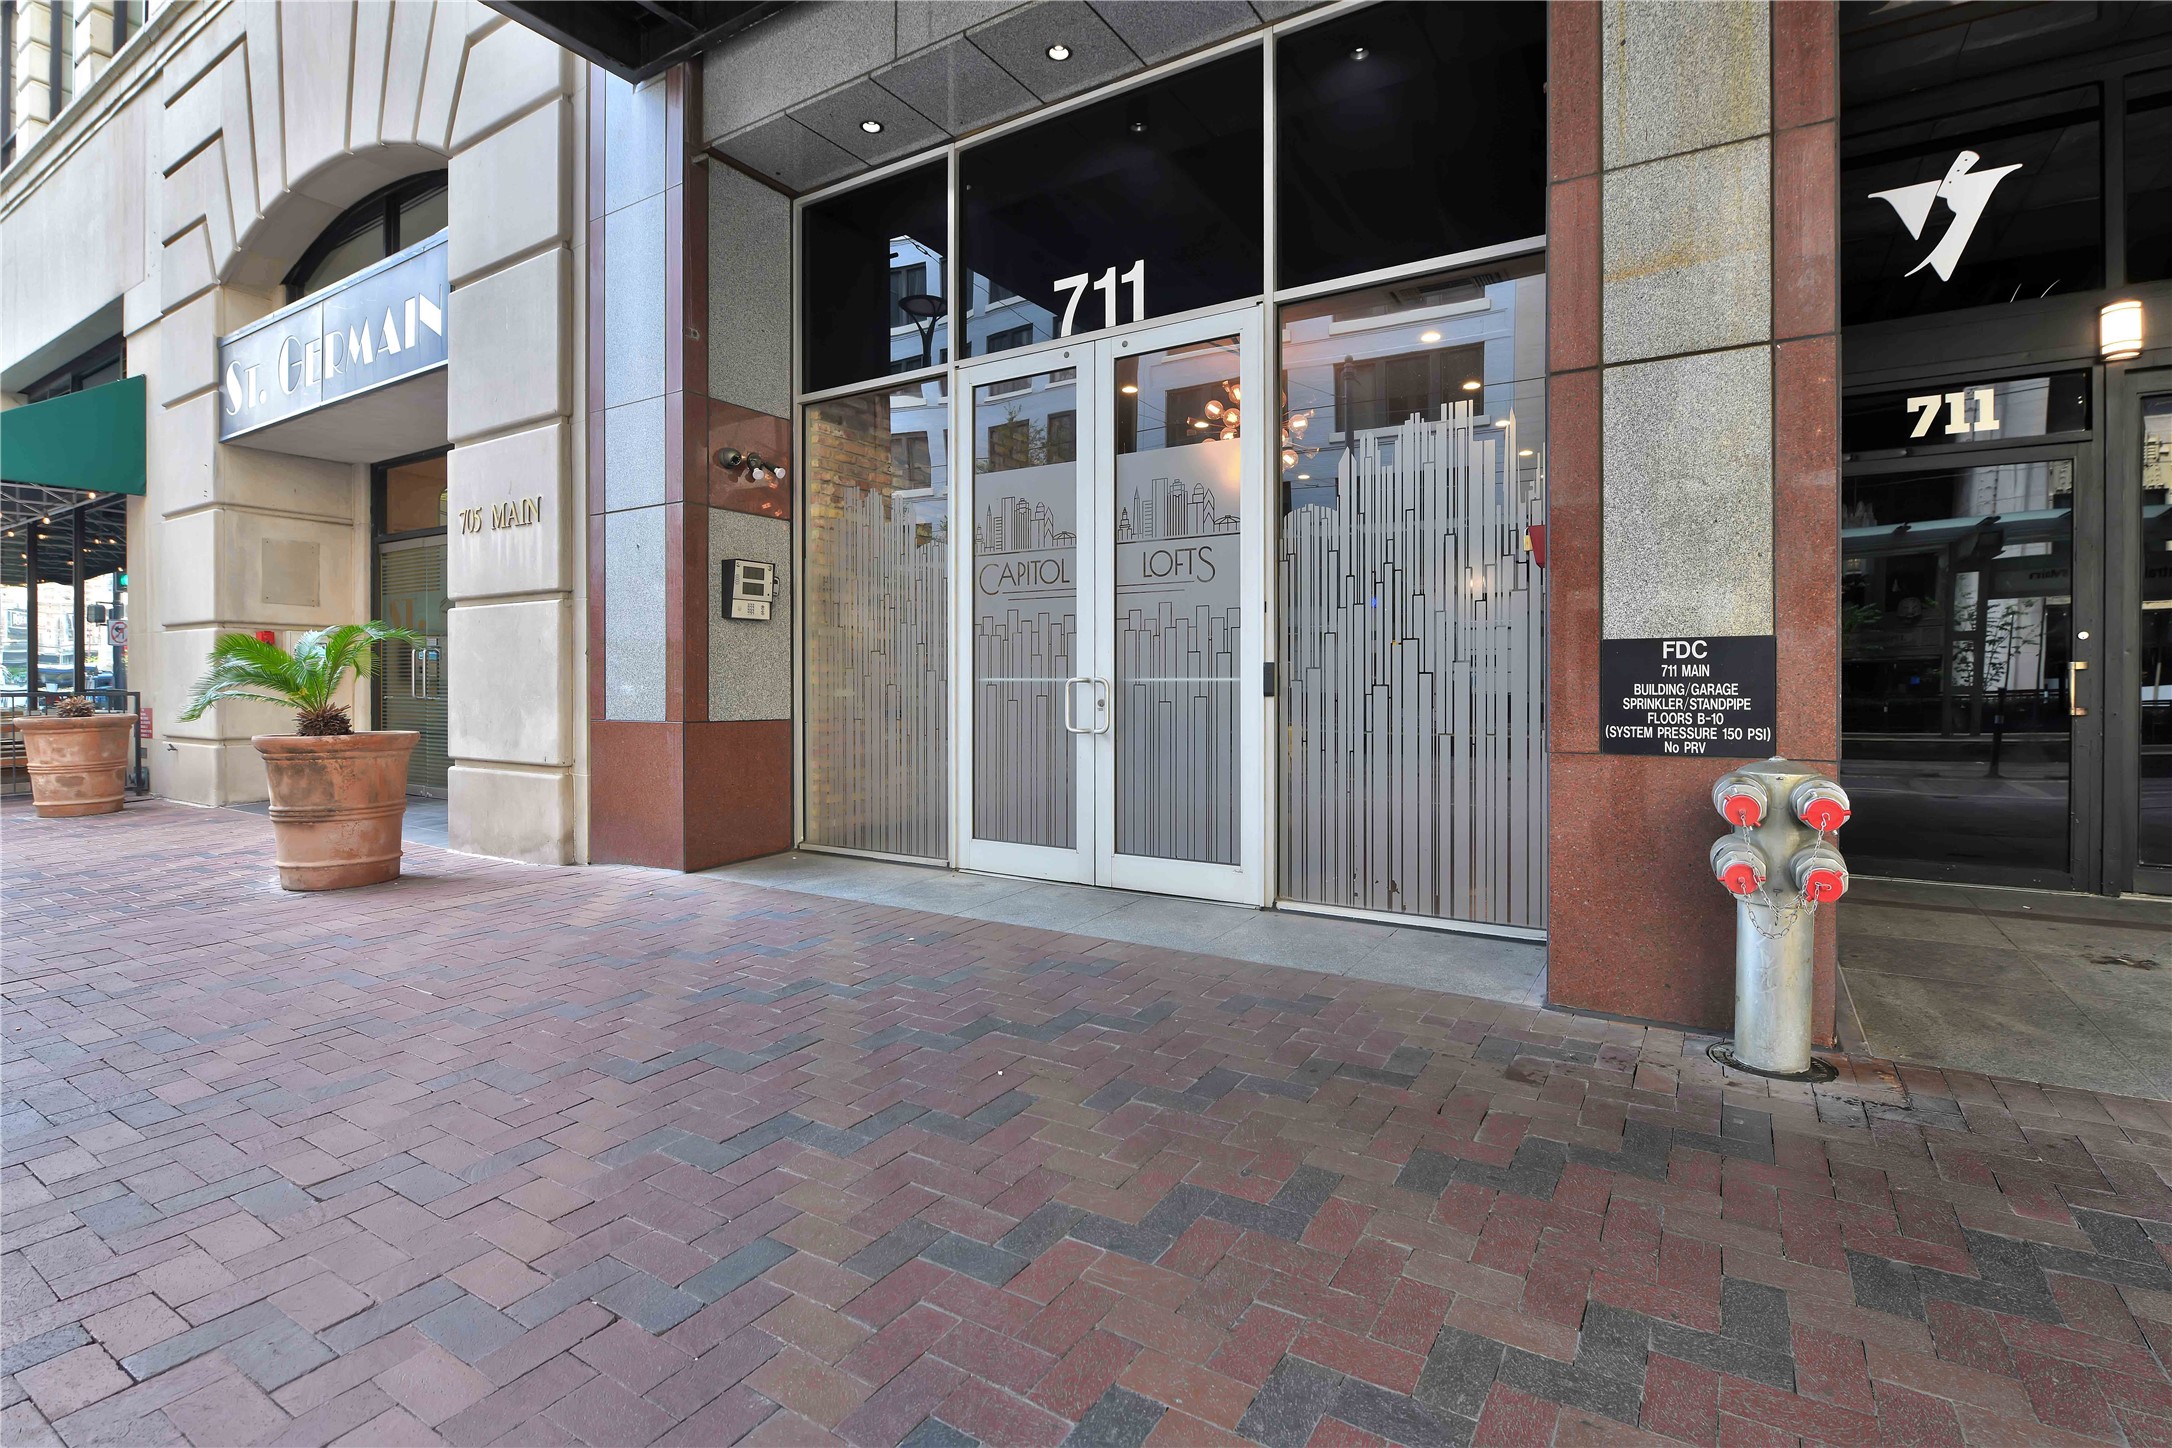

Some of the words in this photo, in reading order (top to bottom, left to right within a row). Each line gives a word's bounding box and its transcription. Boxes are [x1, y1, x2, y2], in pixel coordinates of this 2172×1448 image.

[1054, 259, 1145, 338] 711
[1906, 388, 2000, 438] 711
[459, 507, 483, 535] 705
[491, 496, 542, 531] MAIN
[979, 558, 1070, 595] CAPITOL
[1142, 545, 1216, 583] LOFTS
[1662, 640, 1708, 660] FDC
[1661, 664, 1678, 678] 711
[1681, 664, 1710, 678] MAIN
[1633, 682, 1739, 696] BUILDING/GARAGE
[1622, 697, 1751, 711] SPRINKLER/STANDPIPE
[1647, 712, 1693, 725] FLOORS
[1697, 712, 1724, 726] B-10
[1605, 724, 1653, 739] (SYSTEM
[1657, 726, 1718, 740] PRESSURE
[1722, 727, 1743, 741] 150
[1747, 727, 1771, 742] PSI)
[1664, 741, 1680, 754] No
[1684, 741, 1706, 754] PRV
